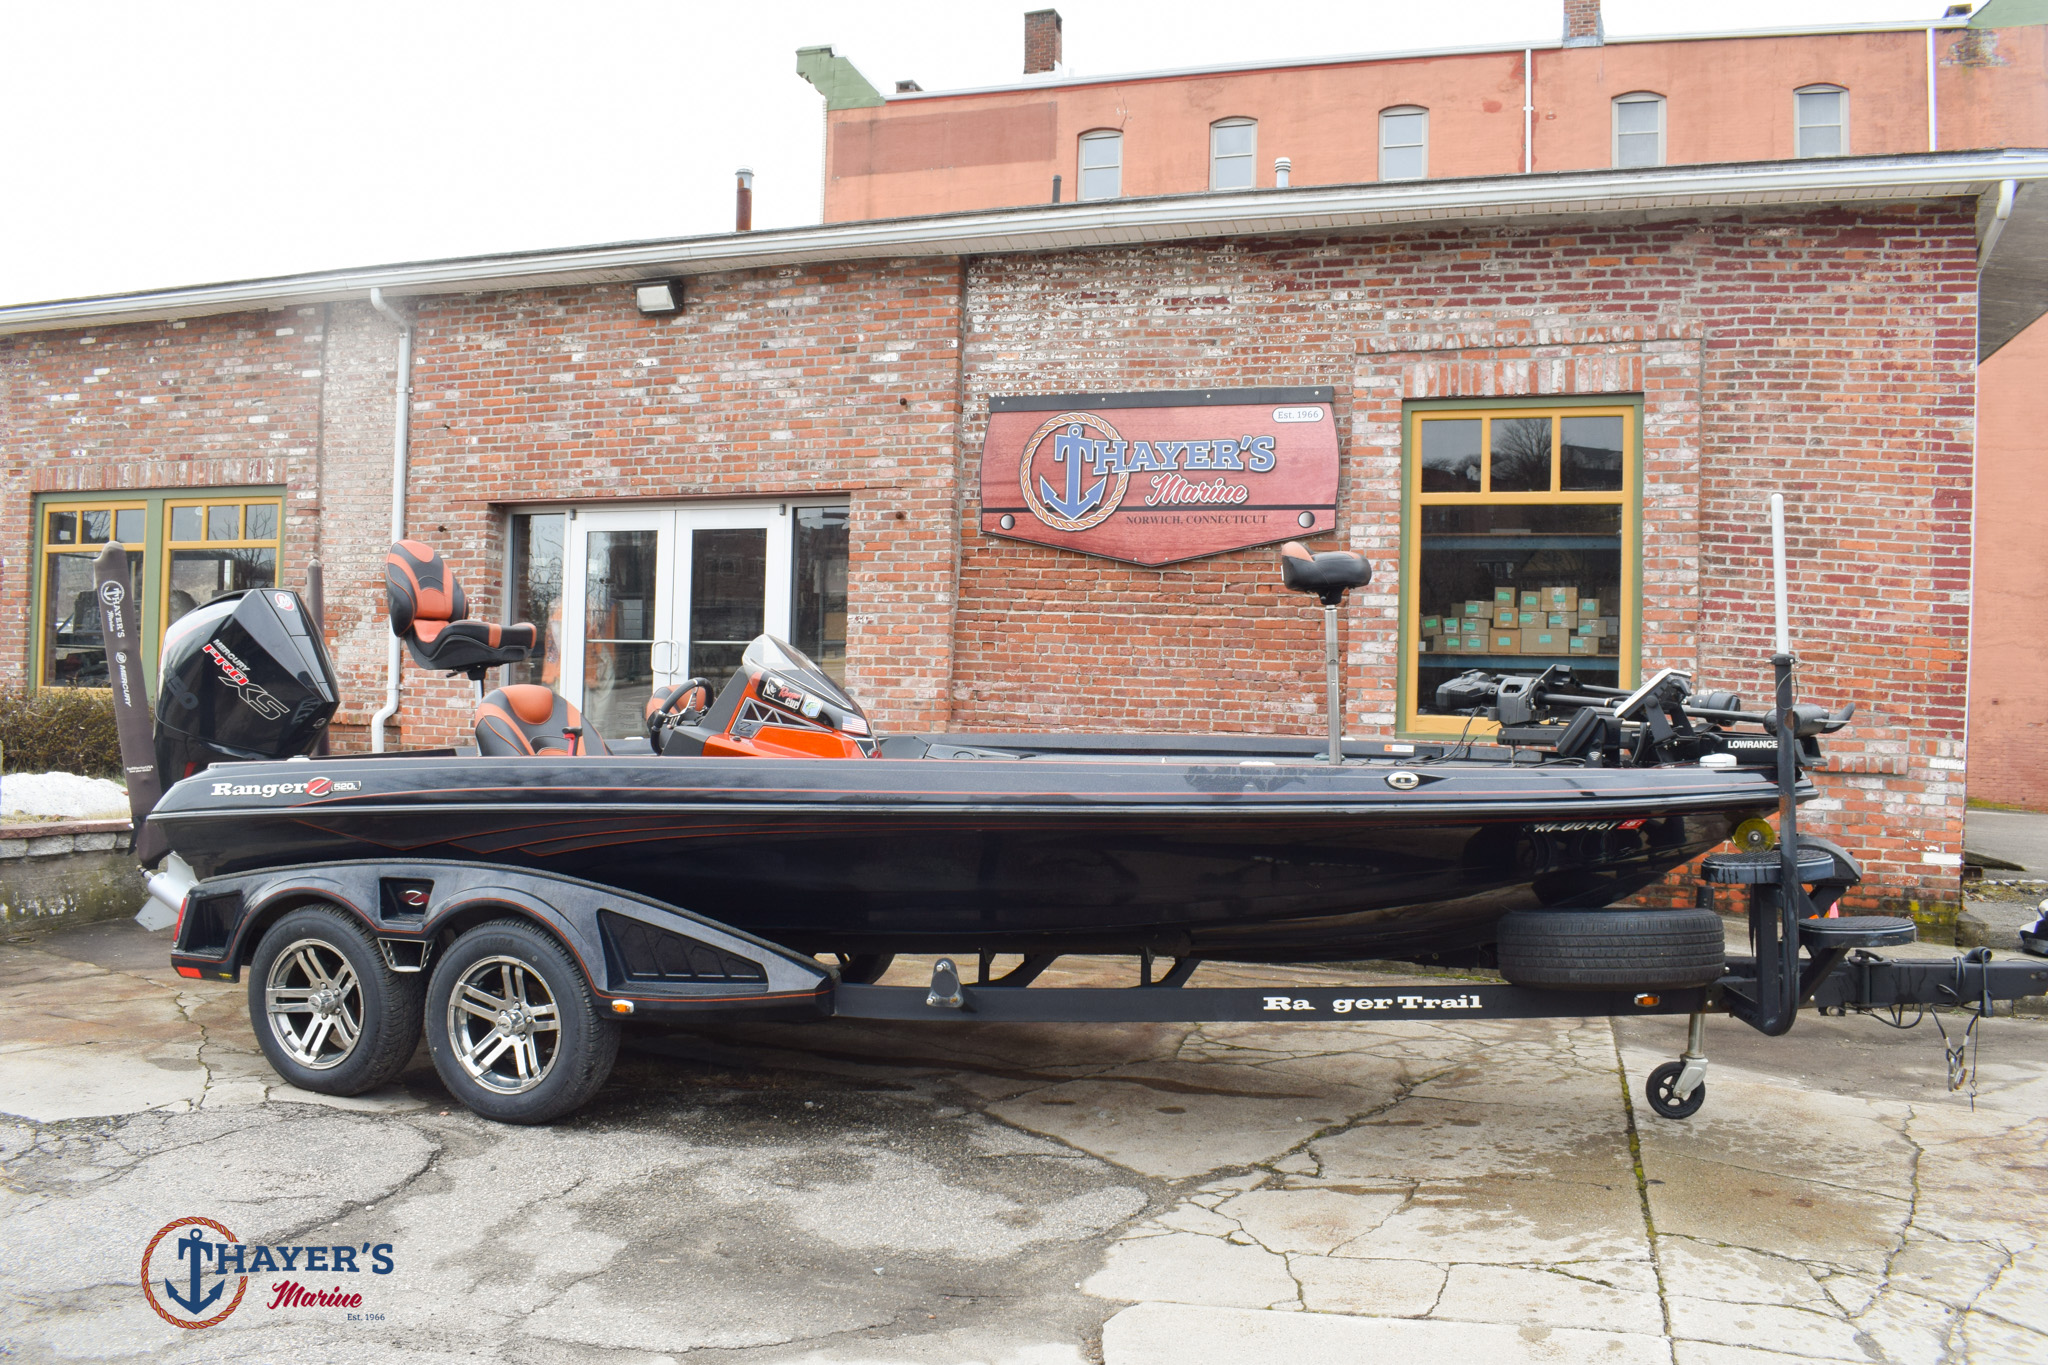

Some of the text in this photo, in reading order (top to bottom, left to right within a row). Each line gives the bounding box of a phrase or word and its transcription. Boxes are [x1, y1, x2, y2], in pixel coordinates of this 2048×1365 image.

[1277, 409, 1319, 419] Est. 1966
[1145, 473, 1248, 507] Marine
[1185, 514, 1269, 525] CONNECTICUT
[202, 643, 249, 685] PRO
[213, 638, 250, 672] MERCURY
[119, 664, 132, 707] MERCURY
[218, 676, 290, 720] XS
[1727, 740, 1779, 749] LOWRANCE
[211, 782, 309, 798] Ranger
